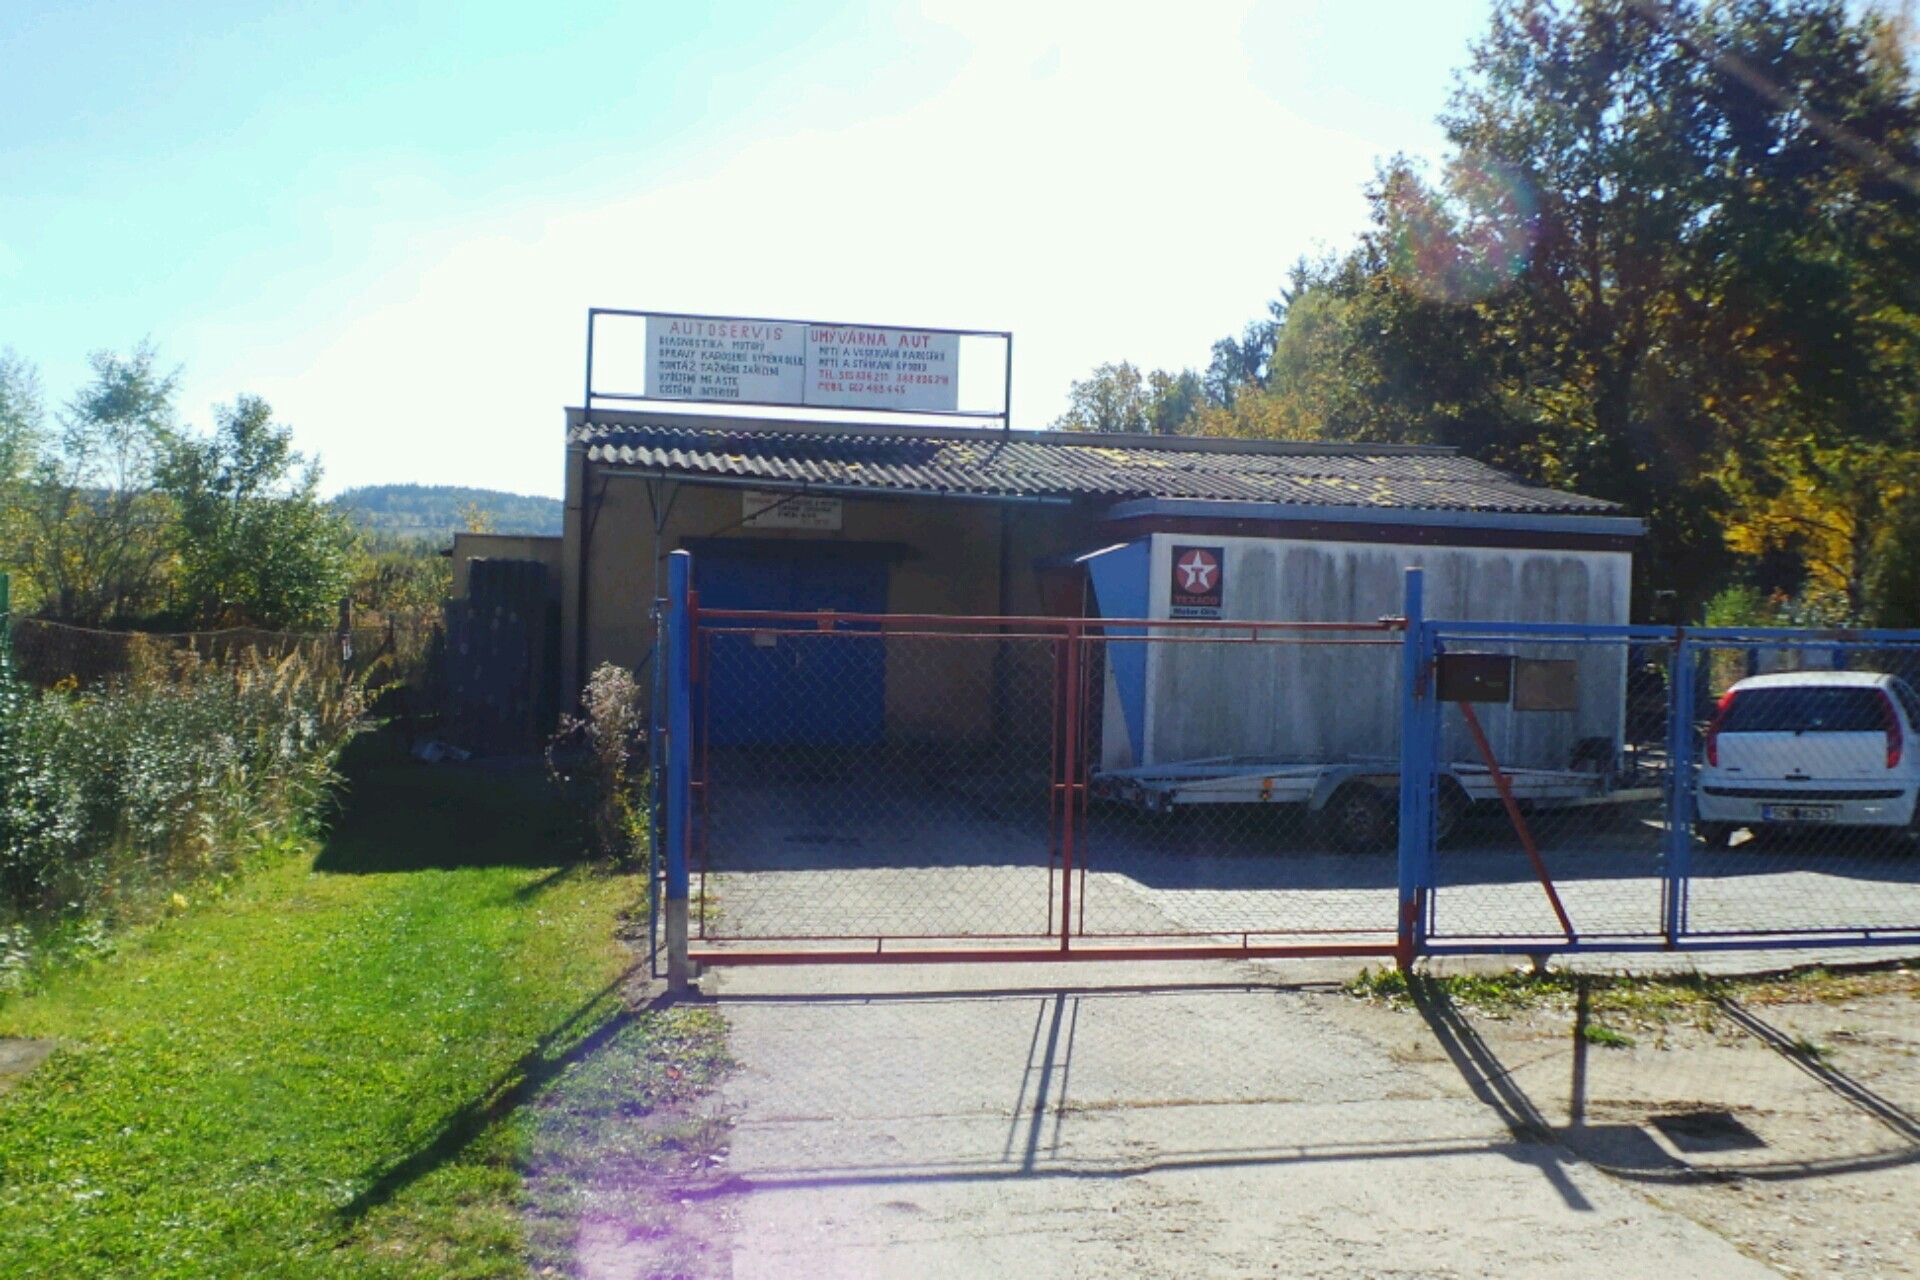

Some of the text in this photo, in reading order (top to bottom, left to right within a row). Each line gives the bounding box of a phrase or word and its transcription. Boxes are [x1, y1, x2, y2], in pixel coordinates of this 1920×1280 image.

[669, 321, 783, 340] AUTOSERVIS
[899, 335, 931, 348] AUT
[659, 348, 696, 358] OPRAVY
[843, 348, 850, 356] A
[659, 361, 696, 371] MONTÁŽ
[843, 360, 850, 368] A
